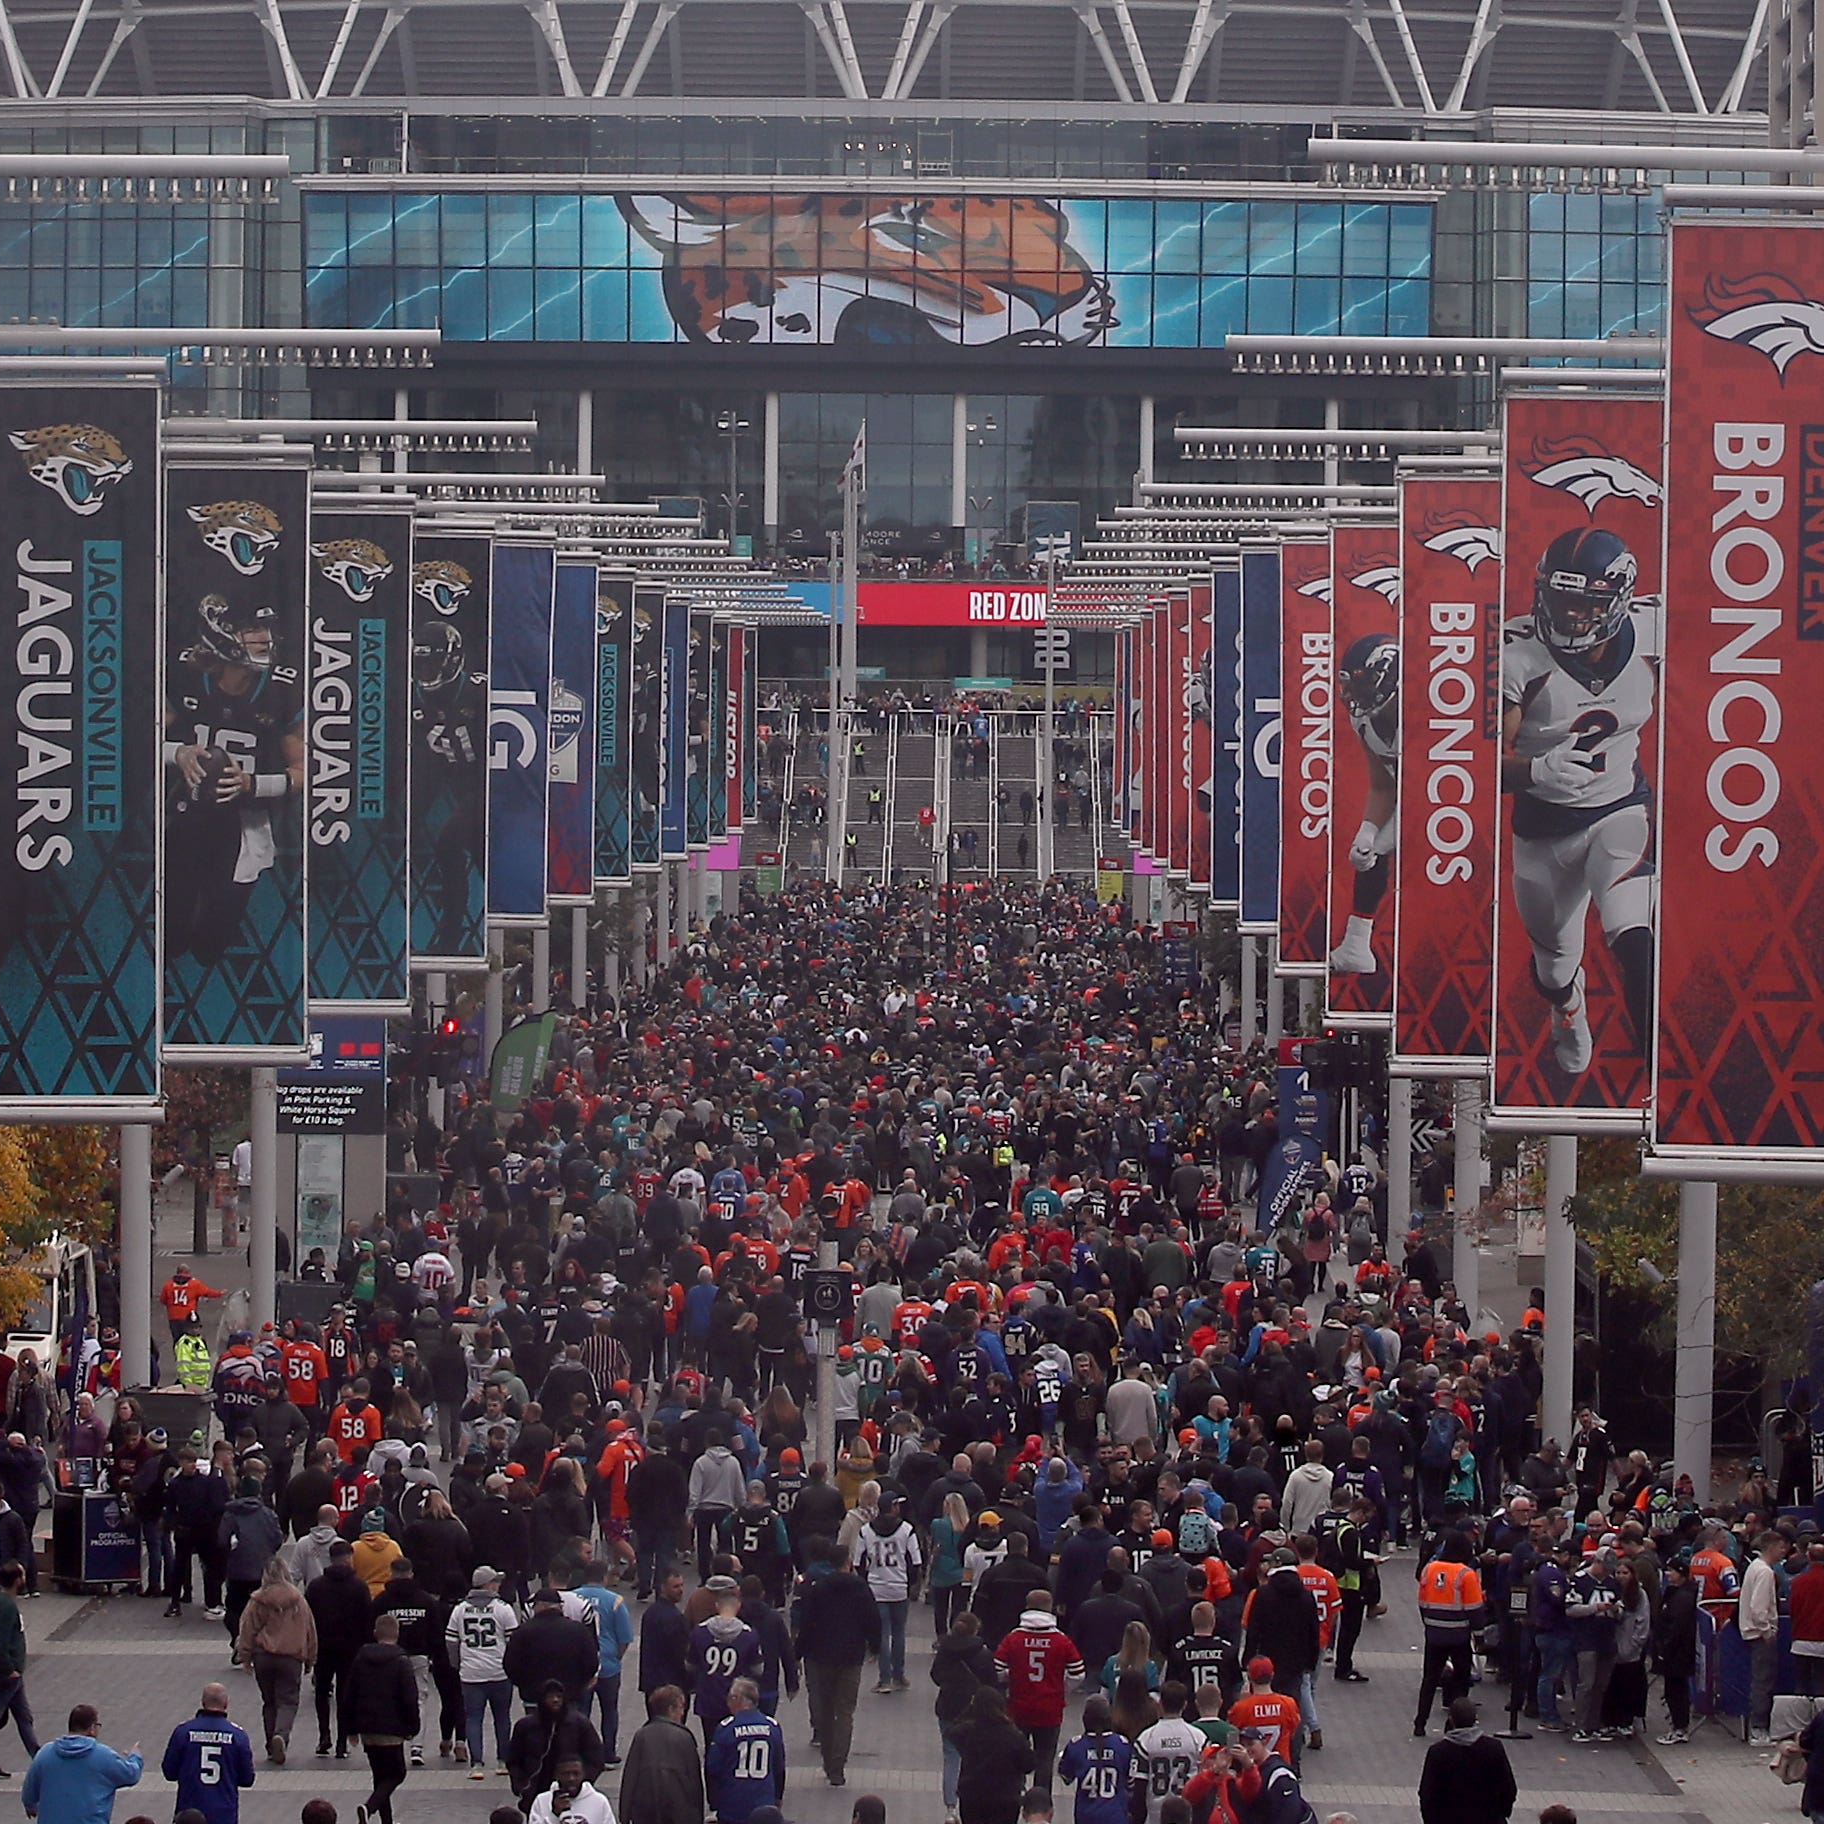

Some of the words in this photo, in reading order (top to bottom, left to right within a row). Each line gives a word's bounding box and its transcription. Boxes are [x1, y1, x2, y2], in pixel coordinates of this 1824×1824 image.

[969, 591, 1005, 621] RED
[1009, 591, 1047, 621] ZON
[1704, 422, 1785, 873] BRONCOS
[87, 548, 117, 824] JACKSONVILLE
[16, 538, 73, 871] JAGUARS
[601, 647, 614, 765] JACKSONVILLE
[311, 617, 352, 845] JAGUARS
[361, 624, 382, 814] JACKSONVILLE
[550, 713, 581, 724] DON
[1300, 632, 1331, 839] BRONCOS
[1426, 602, 1476, 885] BRONCOS
[289, 1086, 312, 1095] drops
[328, 1086, 364, 1095] available
[279, 1106, 302, 1114] White
[303, 1106, 327, 1114] Horse
[327, 1106, 357, 1115] Square
[1270, 1169, 1298, 1212] OFFICIAL
[173, 1289, 188, 1306] 14
[329, 1338, 345, 1358] 18
[288, 1358, 314, 1381] 58
[858, 1358, 883, 1383] 10
[958, 1359, 977, 1379] 52
[1037, 1380, 1061, 1404] 26
[341, 1418, 366, 1439] 58
[339, 1486, 359, 1512] 12
[743, 1526, 760, 1552] 5
[464, 1618, 497, 1648] 52
[1024, 1638, 1051, 1648] LANCE
[706, 1646, 737, 1676] 99
[1028, 1651, 1045, 1682] 5
[1254, 1704, 1281, 1718] ELWAY
[734, 1725, 771, 1738] MANNING
[1161, 1737, 1182, 1749] MOSS
[200, 1745, 222, 1785] 5
[734, 1740, 770, 1779] 10
[1087, 1748, 1114, 1761] MILER
[1081, 1766, 1117, 1799] 40
